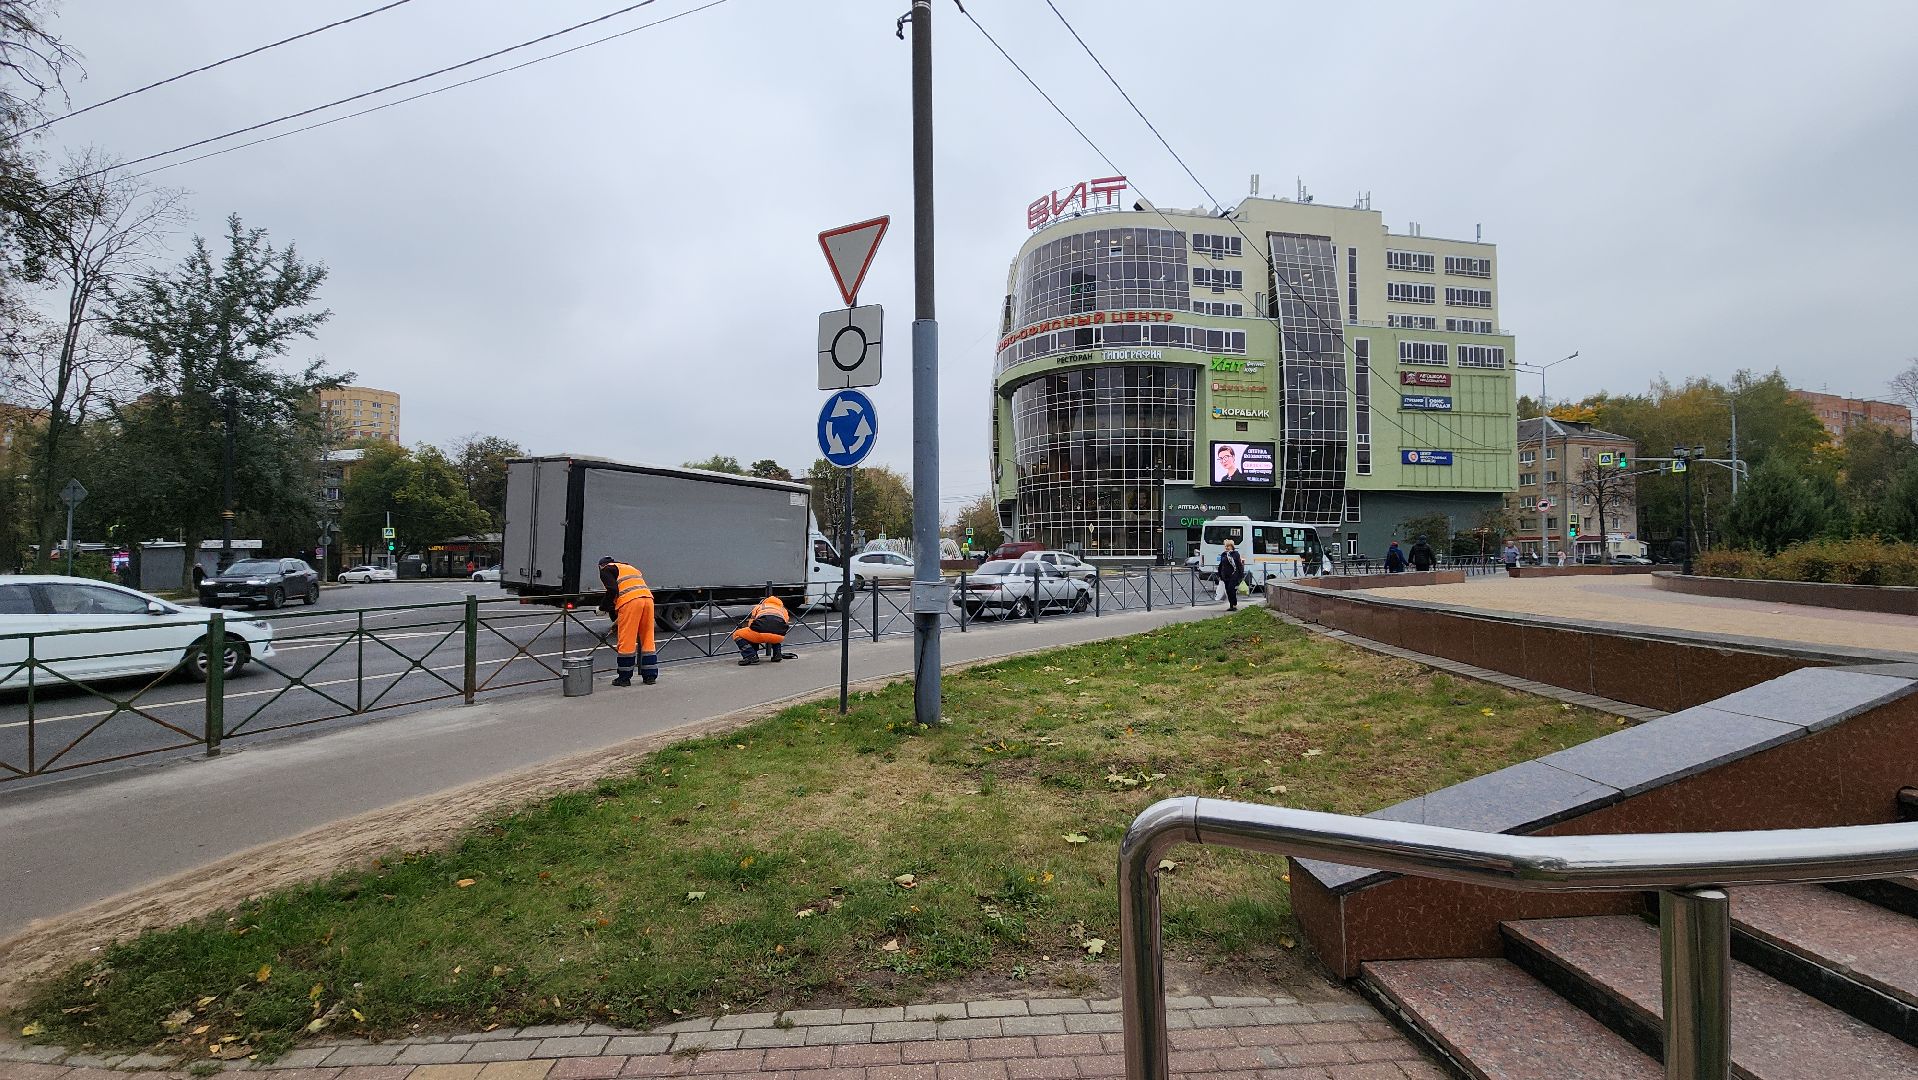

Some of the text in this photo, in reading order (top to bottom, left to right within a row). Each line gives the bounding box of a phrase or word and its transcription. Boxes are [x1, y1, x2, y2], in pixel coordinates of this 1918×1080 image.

[1027, 176, 1127, 229] ВИТ
[1111, 312, 1174, 324] ЦЕНТР
[1056, 353, 1093, 364] РЕСТОРАН
[1101, 349, 1162, 361] ТИПОГРАФИЯ
[1222, 408, 1269, 418] КОРАБЛИК
